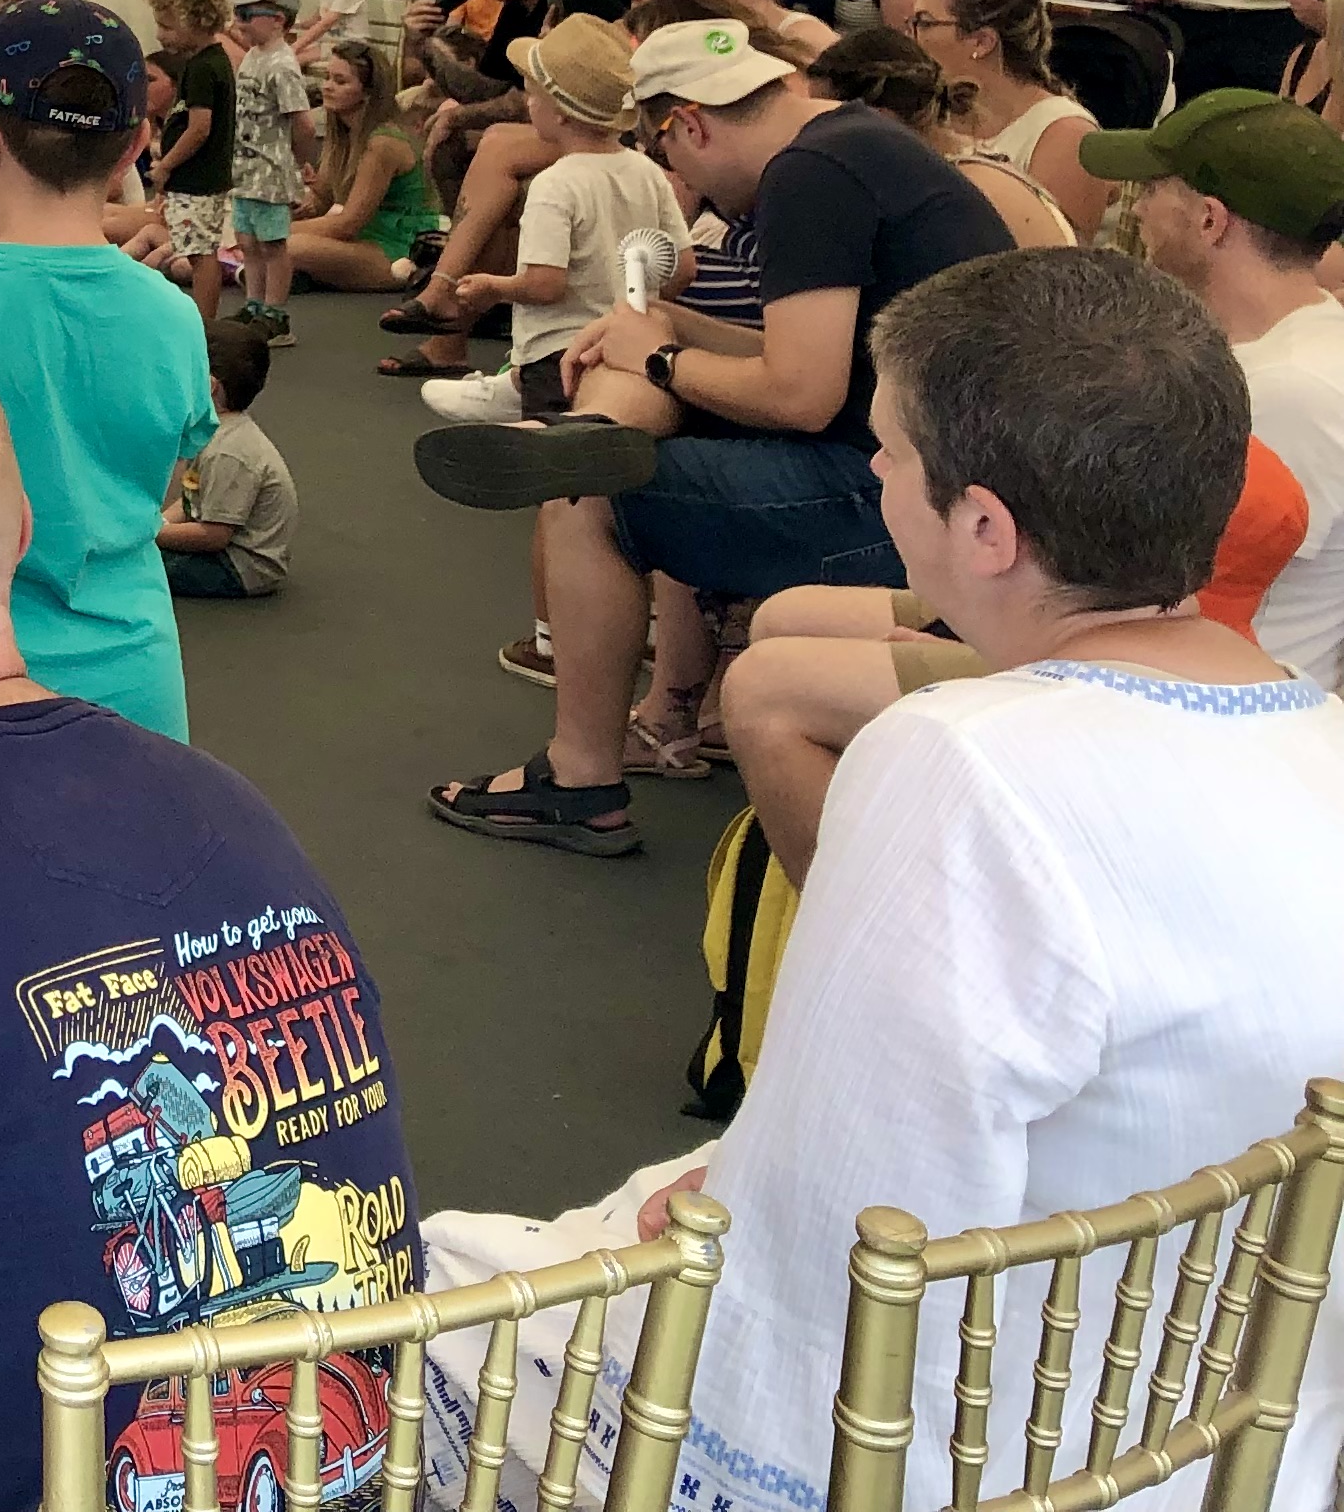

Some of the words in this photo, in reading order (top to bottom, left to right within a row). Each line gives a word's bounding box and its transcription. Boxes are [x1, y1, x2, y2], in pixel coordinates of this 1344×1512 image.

[49, 108, 101, 126] FATFACE
[174, 931, 218, 967] How
[221, 921, 242, 946] to
[248, 904, 280, 950] get
[42, 982, 96, 1019] Fat
[100, 969, 159, 999] Face
[174, 931, 355, 1023] VOLKSWAGEN
[205, 987, 380, 1140] BEETLE
[275, 1105, 329, 1147] READY
[333, 1094, 363, 1127] FOR
[361, 1080, 388, 1114] YOUR
[334, 1176, 405, 1274] ROAD
[353, 1244, 414, 1306] TRIP!
